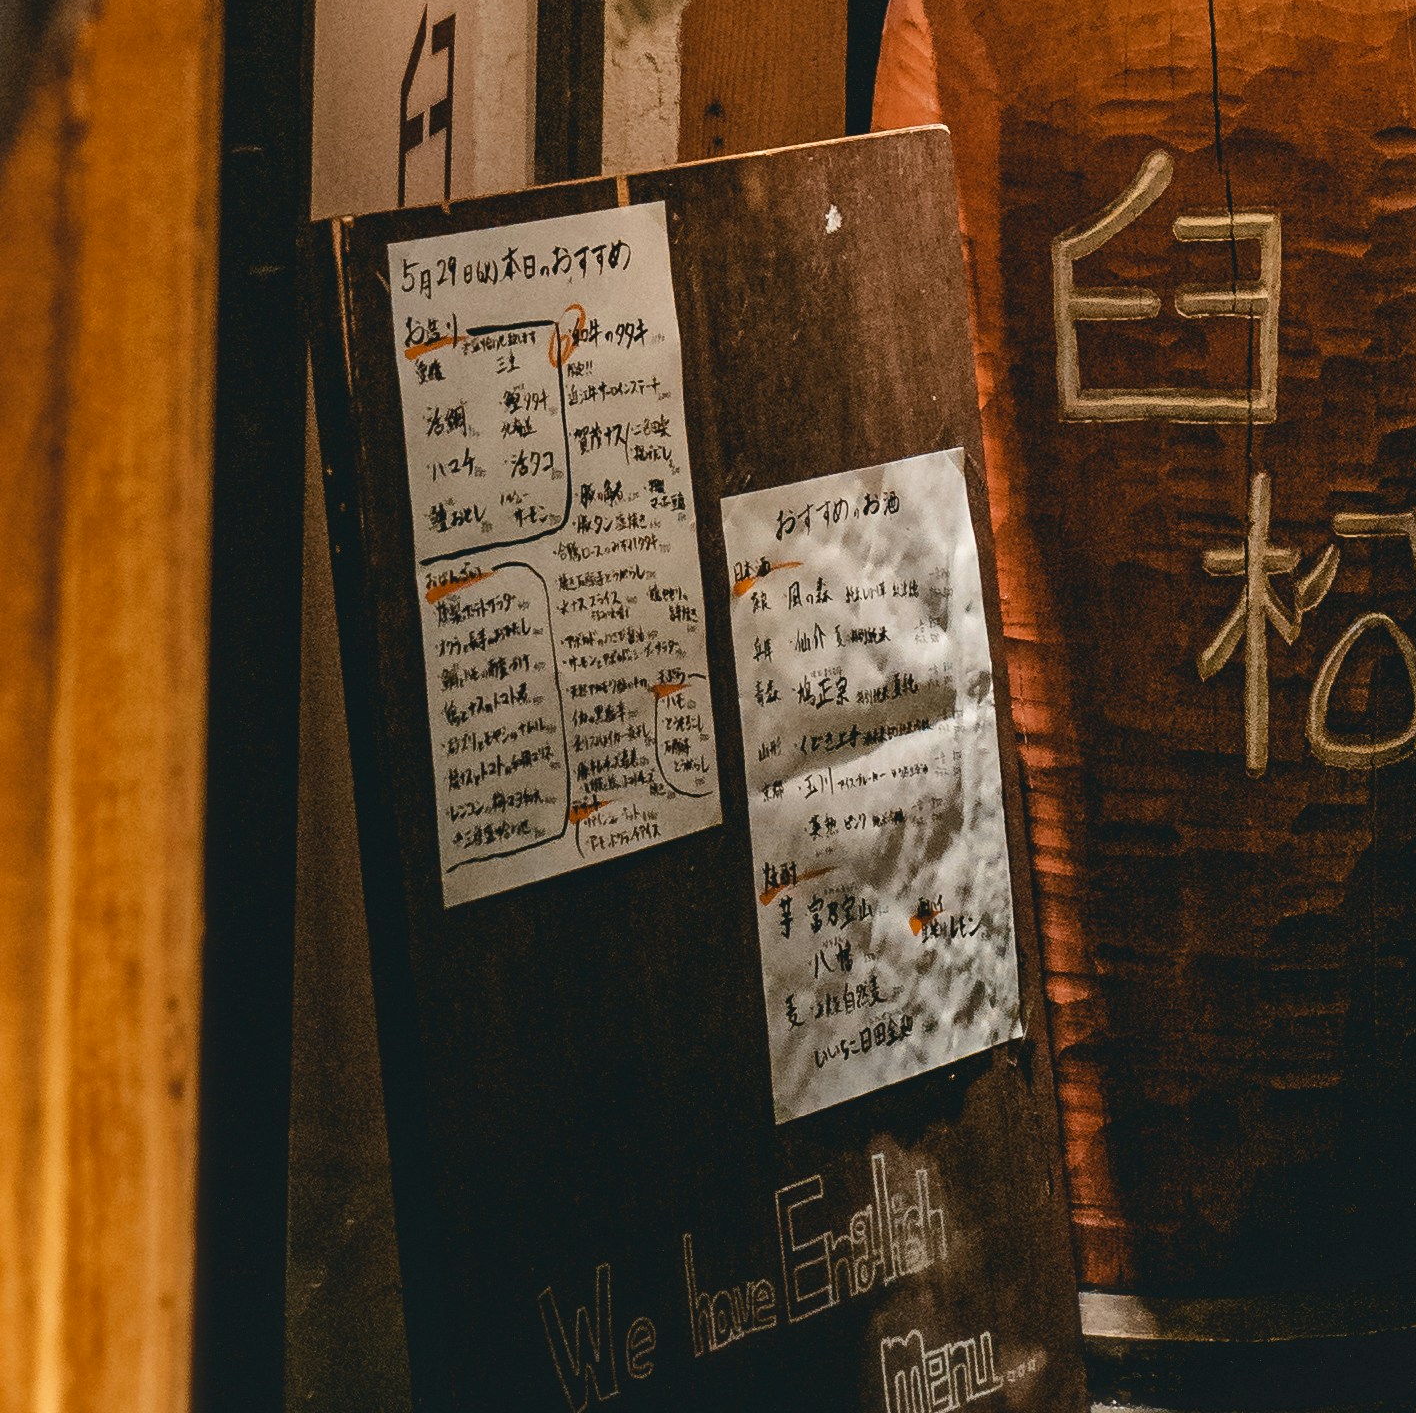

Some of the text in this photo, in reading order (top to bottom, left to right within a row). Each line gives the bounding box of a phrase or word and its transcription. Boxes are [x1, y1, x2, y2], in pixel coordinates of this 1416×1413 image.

[776, 490, 900, 541] おすすめのお酒
[537, 1153, 948, 1413] We have English
